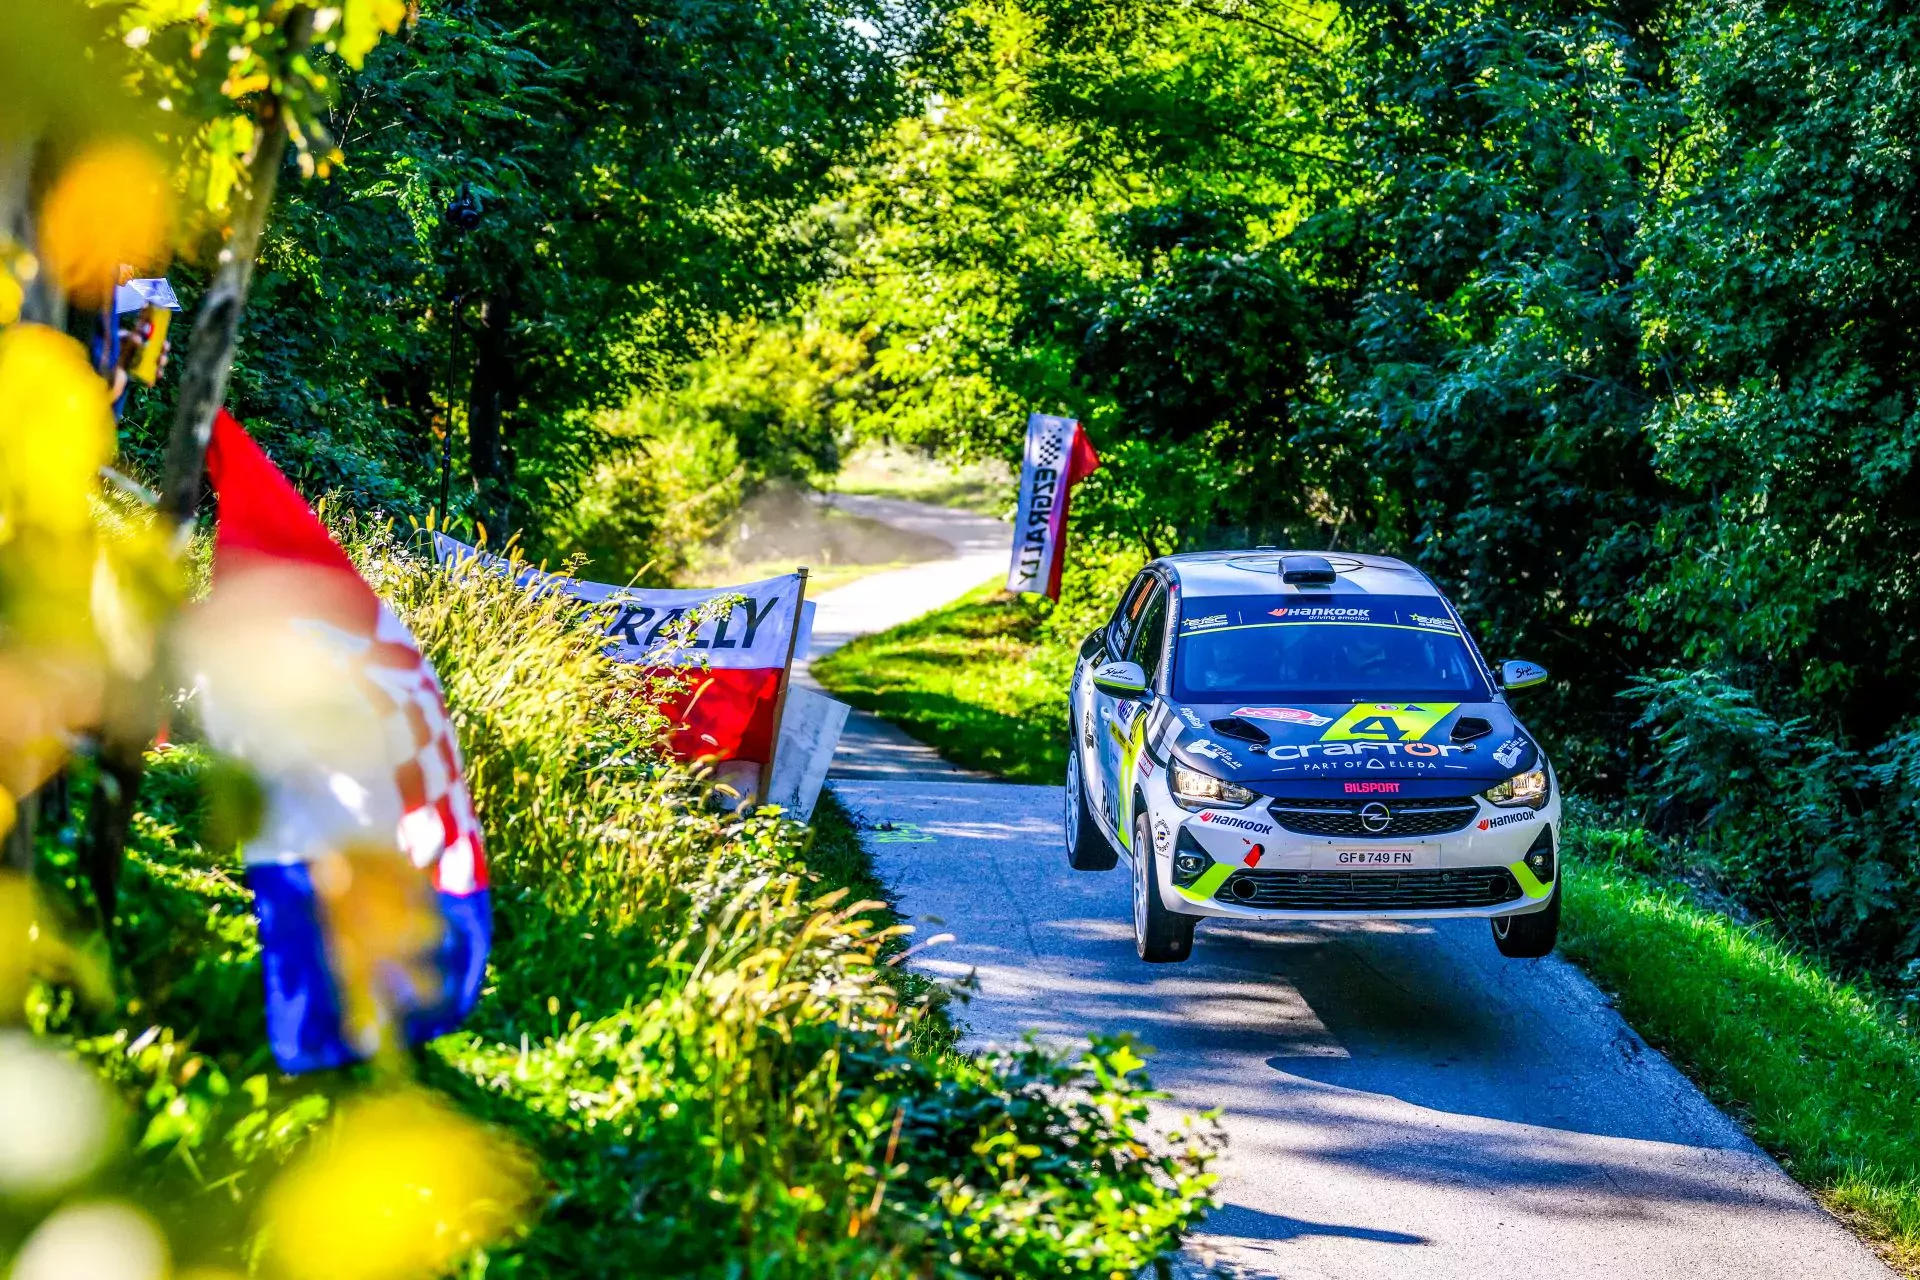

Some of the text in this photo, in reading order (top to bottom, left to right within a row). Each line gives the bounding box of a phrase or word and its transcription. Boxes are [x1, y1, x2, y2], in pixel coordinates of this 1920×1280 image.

[571, 597, 779, 649] RALLY
[1303, 760, 1437, 771] PART OF ELEDA
[1343, 783, 1401, 793] BILSPORT
[1338, 852, 1412, 863] GF 749 FN
